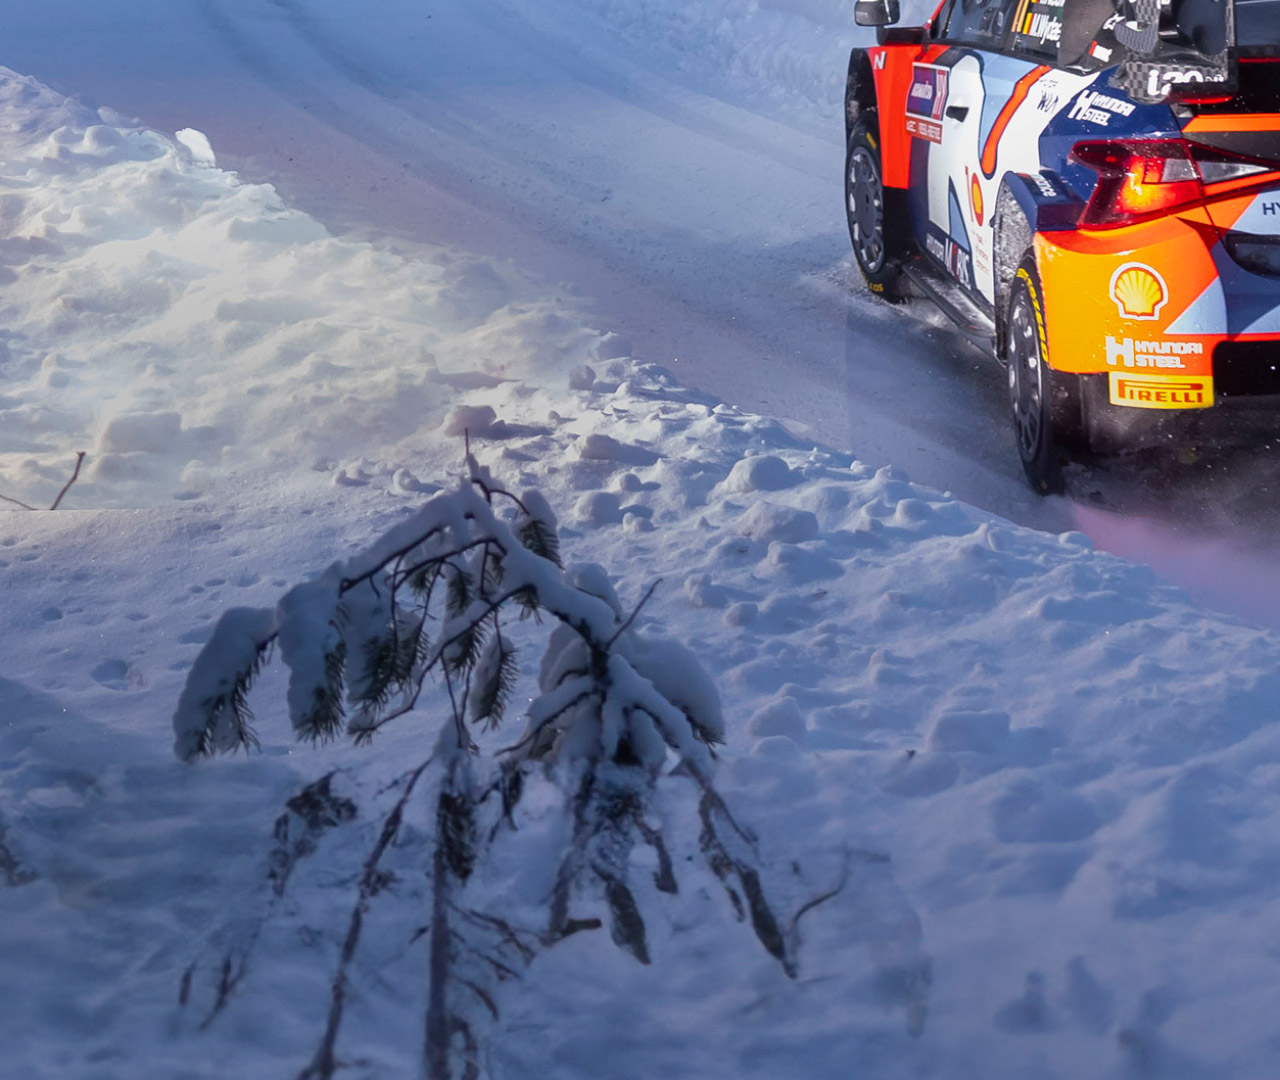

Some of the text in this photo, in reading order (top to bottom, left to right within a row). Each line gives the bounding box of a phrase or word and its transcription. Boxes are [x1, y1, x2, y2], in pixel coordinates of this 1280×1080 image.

[1082, 108, 1112, 126] STEEL
[1135, 341, 1203, 354] HYUNDAI
[1136, 356, 1186, 368] STEEL
[1117, 379, 1204, 403] PIRELLI
